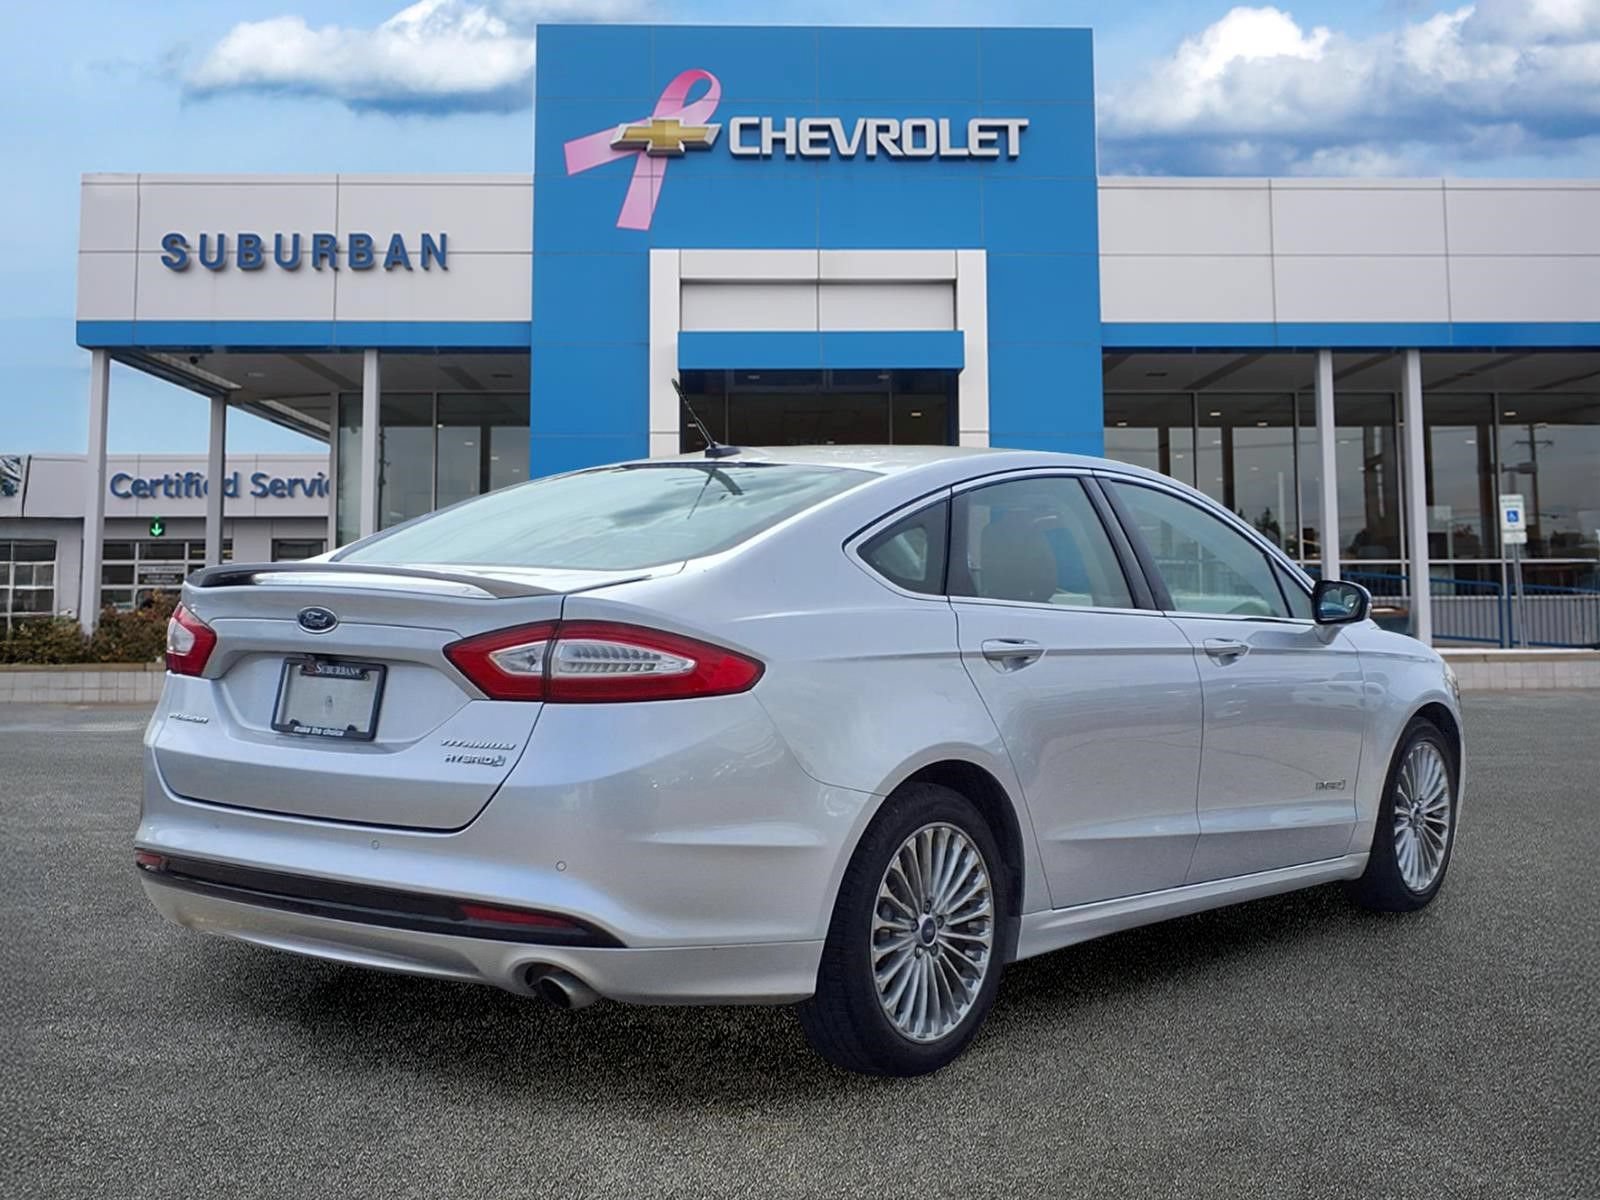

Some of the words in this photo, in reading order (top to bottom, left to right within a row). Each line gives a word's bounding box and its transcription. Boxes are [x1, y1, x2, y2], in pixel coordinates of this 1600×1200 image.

[728, 116, 1030, 159] CHEVROLET
[160, 232, 449, 272] SUBURBAN
[109, 471, 240, 498] Certifid
[249, 471, 330, 498] Servi
[441, 739, 517, 751] TITANIUM
[444, 754, 495, 766] HYBRID
